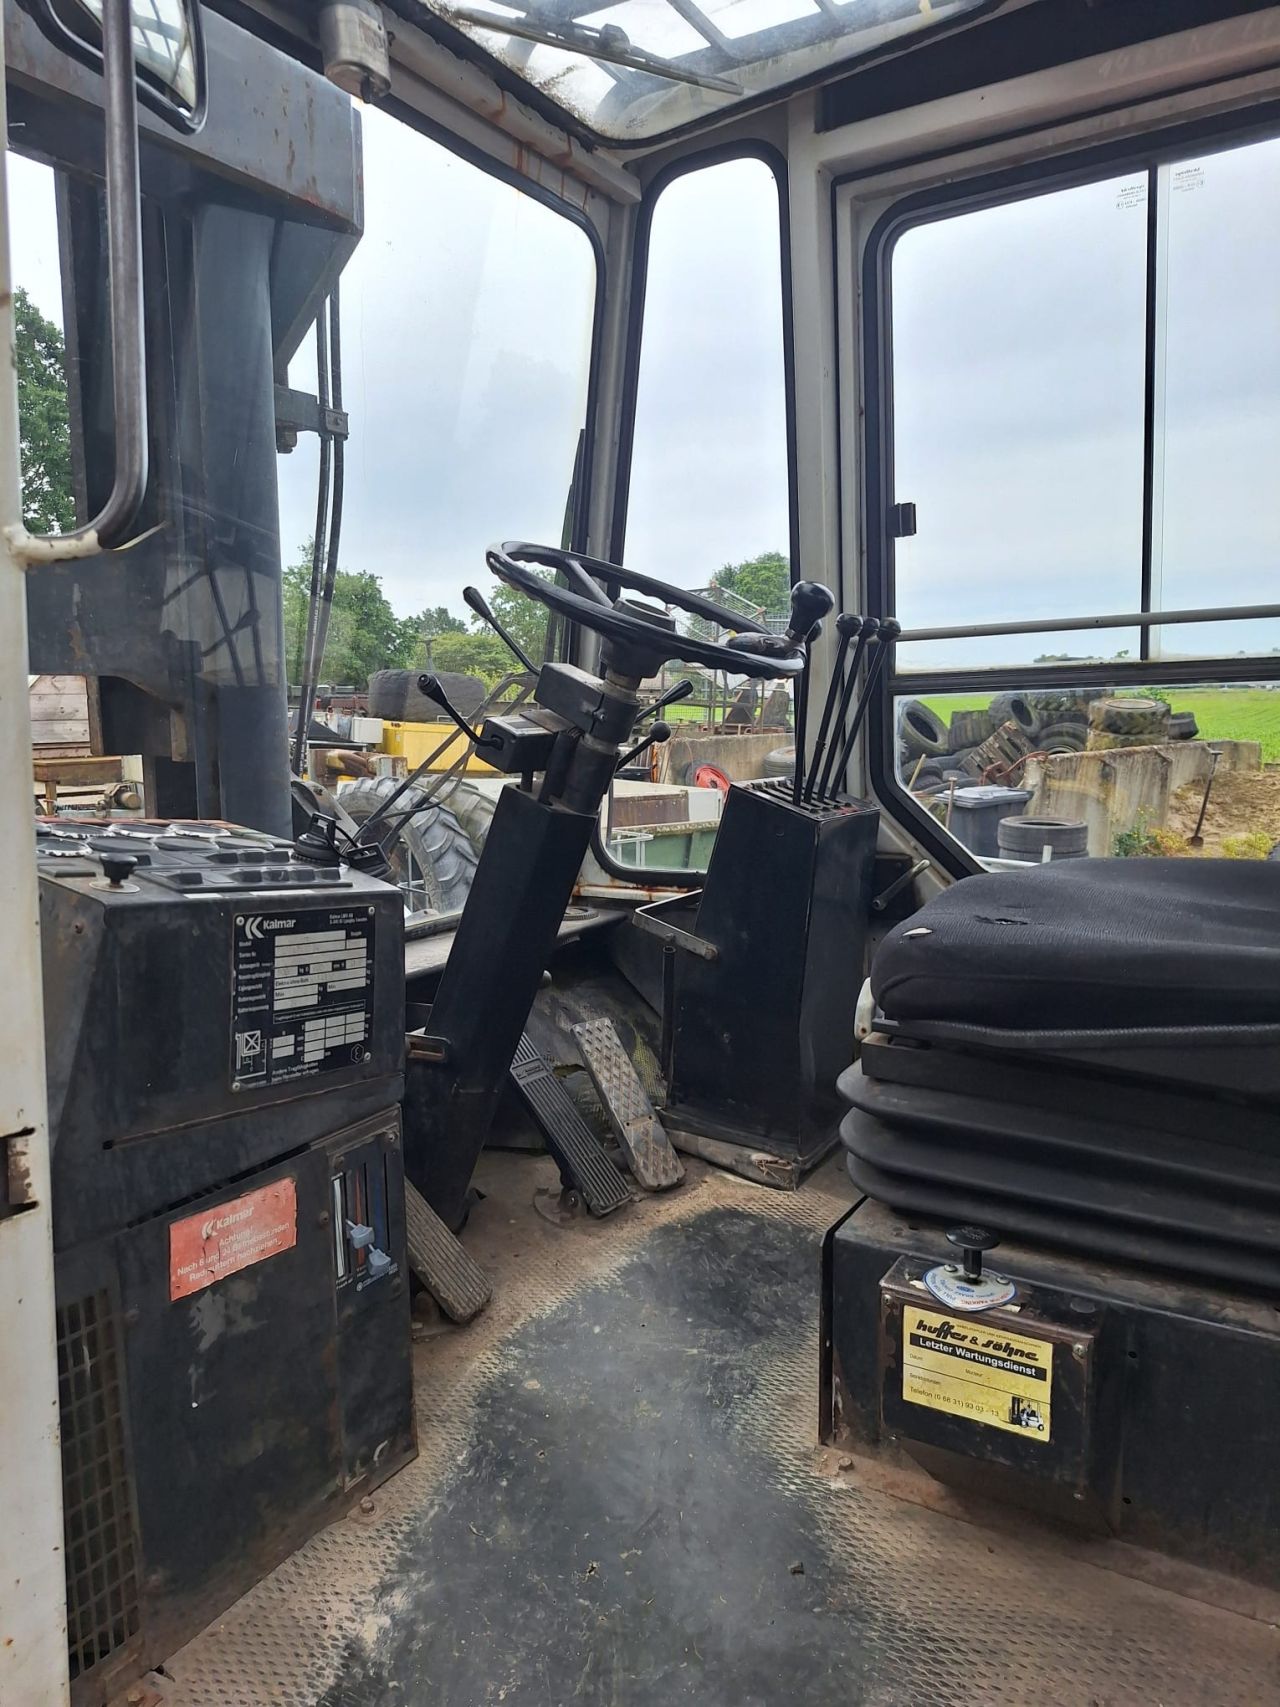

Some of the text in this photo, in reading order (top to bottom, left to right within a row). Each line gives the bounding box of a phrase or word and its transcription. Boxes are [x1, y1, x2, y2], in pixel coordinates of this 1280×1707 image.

[263, 919, 296, 930] Kalmar
[177, 1261, 198, 1276] Nach
[969, 1335, 979, 1346] &
[920, 1337, 1036, 1377] Letzter Wartungsdienst
[910, 1386, 933, 1399] Telefon
